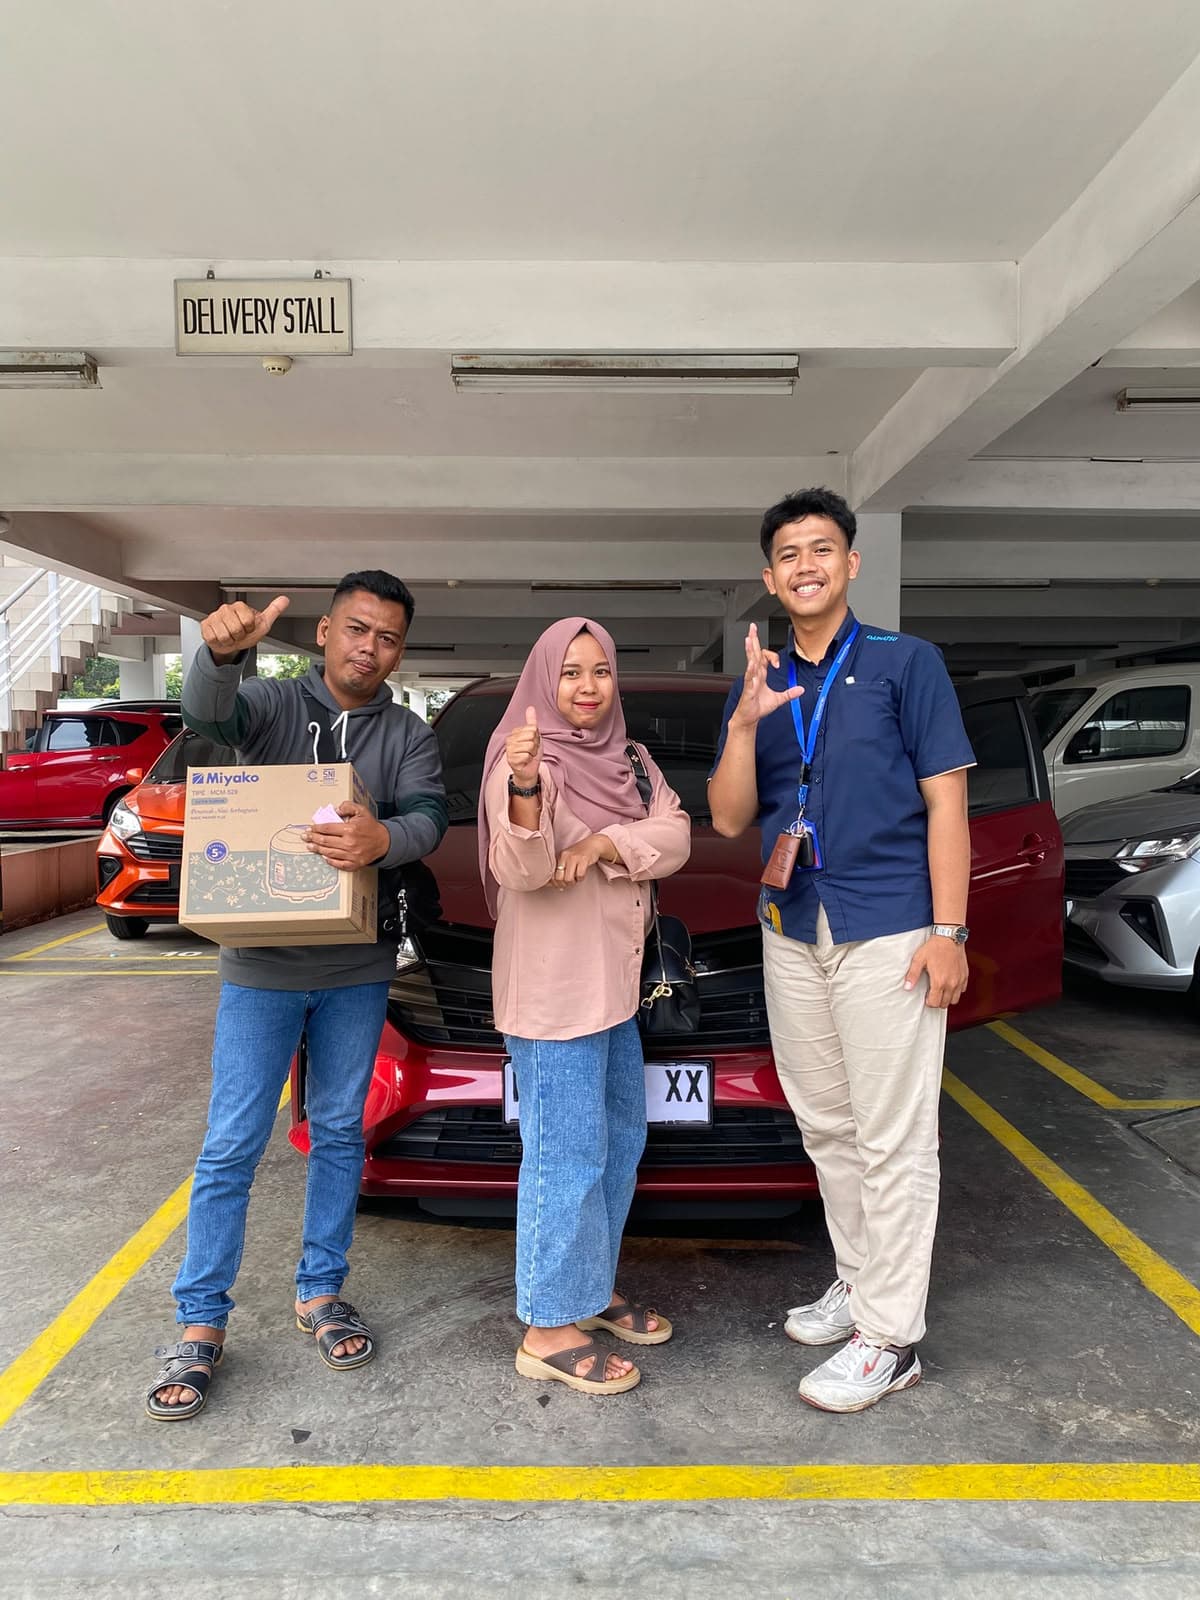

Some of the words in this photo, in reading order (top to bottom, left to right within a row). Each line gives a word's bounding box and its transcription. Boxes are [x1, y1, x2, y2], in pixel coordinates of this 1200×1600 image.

[283, 297, 344, 334] STALL
[206, 771, 260, 787] Miyako
[211, 848, 219, 858] 5
[665, 1069, 704, 1103] XX
